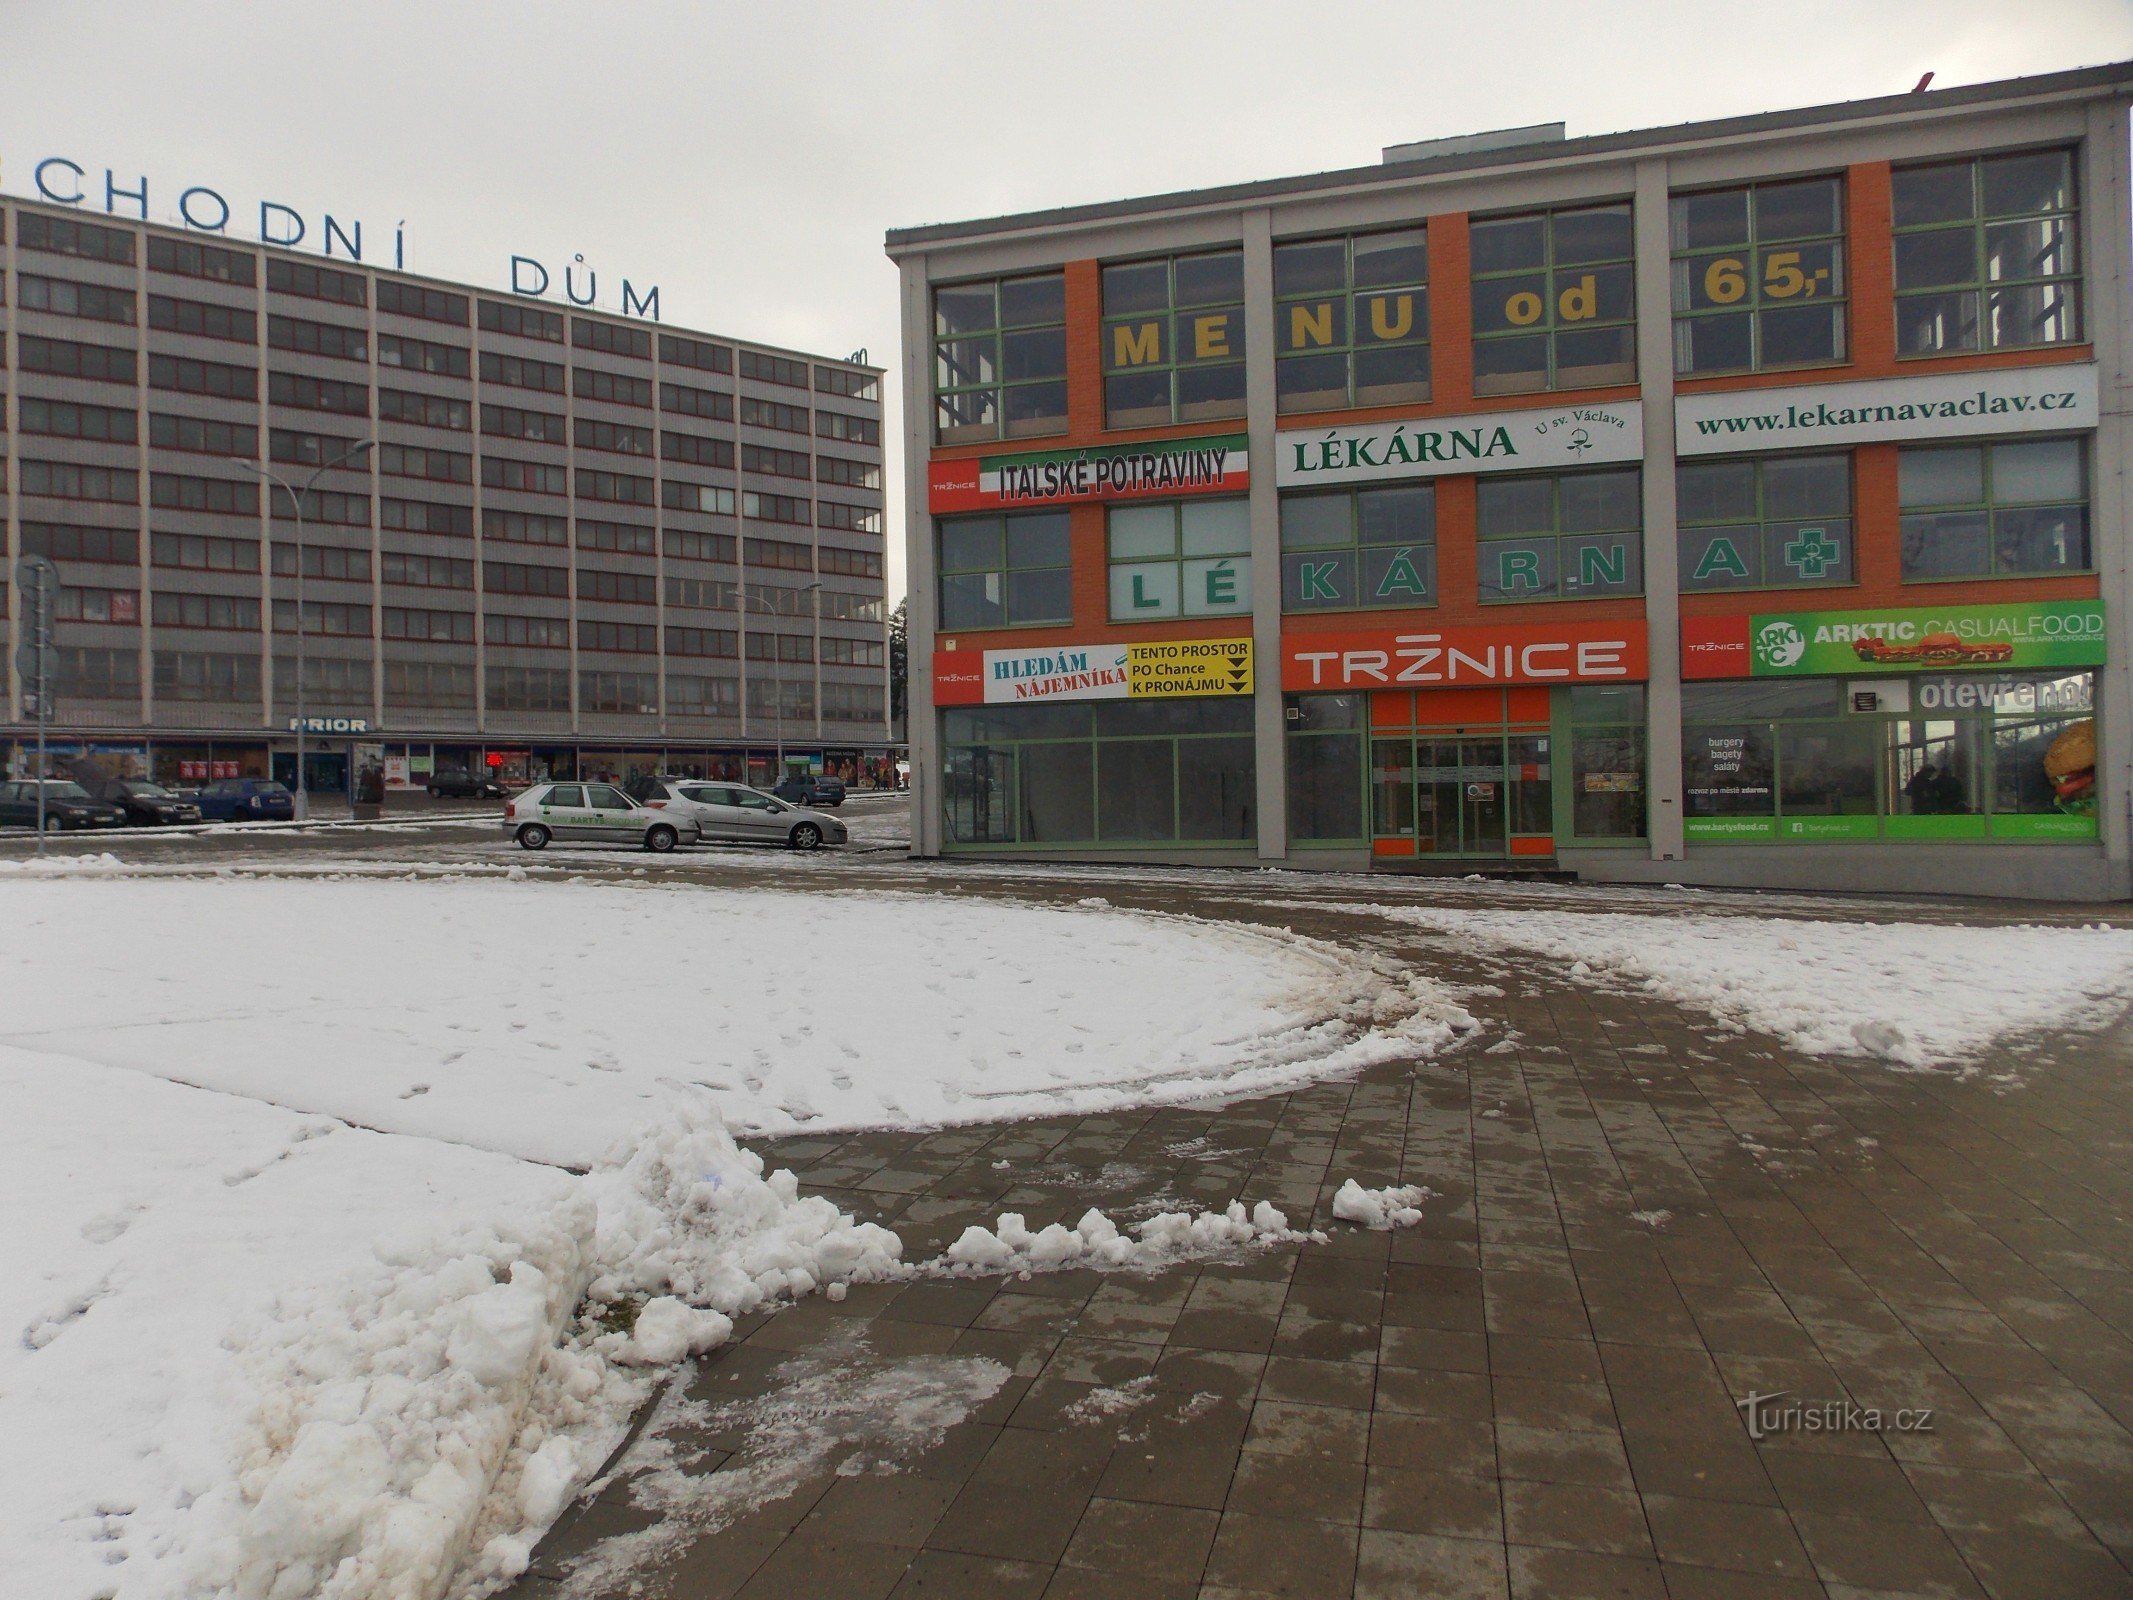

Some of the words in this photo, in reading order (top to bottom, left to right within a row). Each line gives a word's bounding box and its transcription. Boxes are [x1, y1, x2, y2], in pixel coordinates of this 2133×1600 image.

[511, 253, 660, 322] DŮM
[1114, 295, 1413, 367] MENU
[1506, 275, 1597, 326] od
[1534, 421, 1548, 435] U
[1552, 416, 1568, 428] sv.
[1572, 410, 1625, 429] Václava
[1695, 390, 2077, 436] www.lekarnavaclav.cz
[1292, 425, 1519, 473] LÉKÁRNA
[999, 451, 1089, 500] ITALSKÉ
[1095, 446, 1229, 494] POTRAVINY
[1813, 621, 1916, 644] ARKTIC
[1131, 645, 1178, 660] TENTO
[1181, 642, 1248, 657] PROSTOR
[1688, 642, 1745, 652] TRŽNICE
[993, 650, 1088, 680] HLEDÁM
[1293, 633, 1628, 685] TRŽNICE
[937, 672, 981, 683] TRŽNICE
[1132, 664, 1152, 677] PO
[1156, 662, 1206, 675] Chance
[1014, 667, 1127, 699] NÁJEMNÍKA
[1132, 681, 1142, 694] K
[1144, 676, 1225, 693] PRONÁJMU
[289, 717, 367, 733] PRIOR
[1708, 737, 1744, 748] burgery
[1711, 749, 1742, 760] bagety
[1713, 761, 1740, 772] saláty
[1710, 788, 1718, 796] po
[1741, 786, 1769, 794] zdarma
